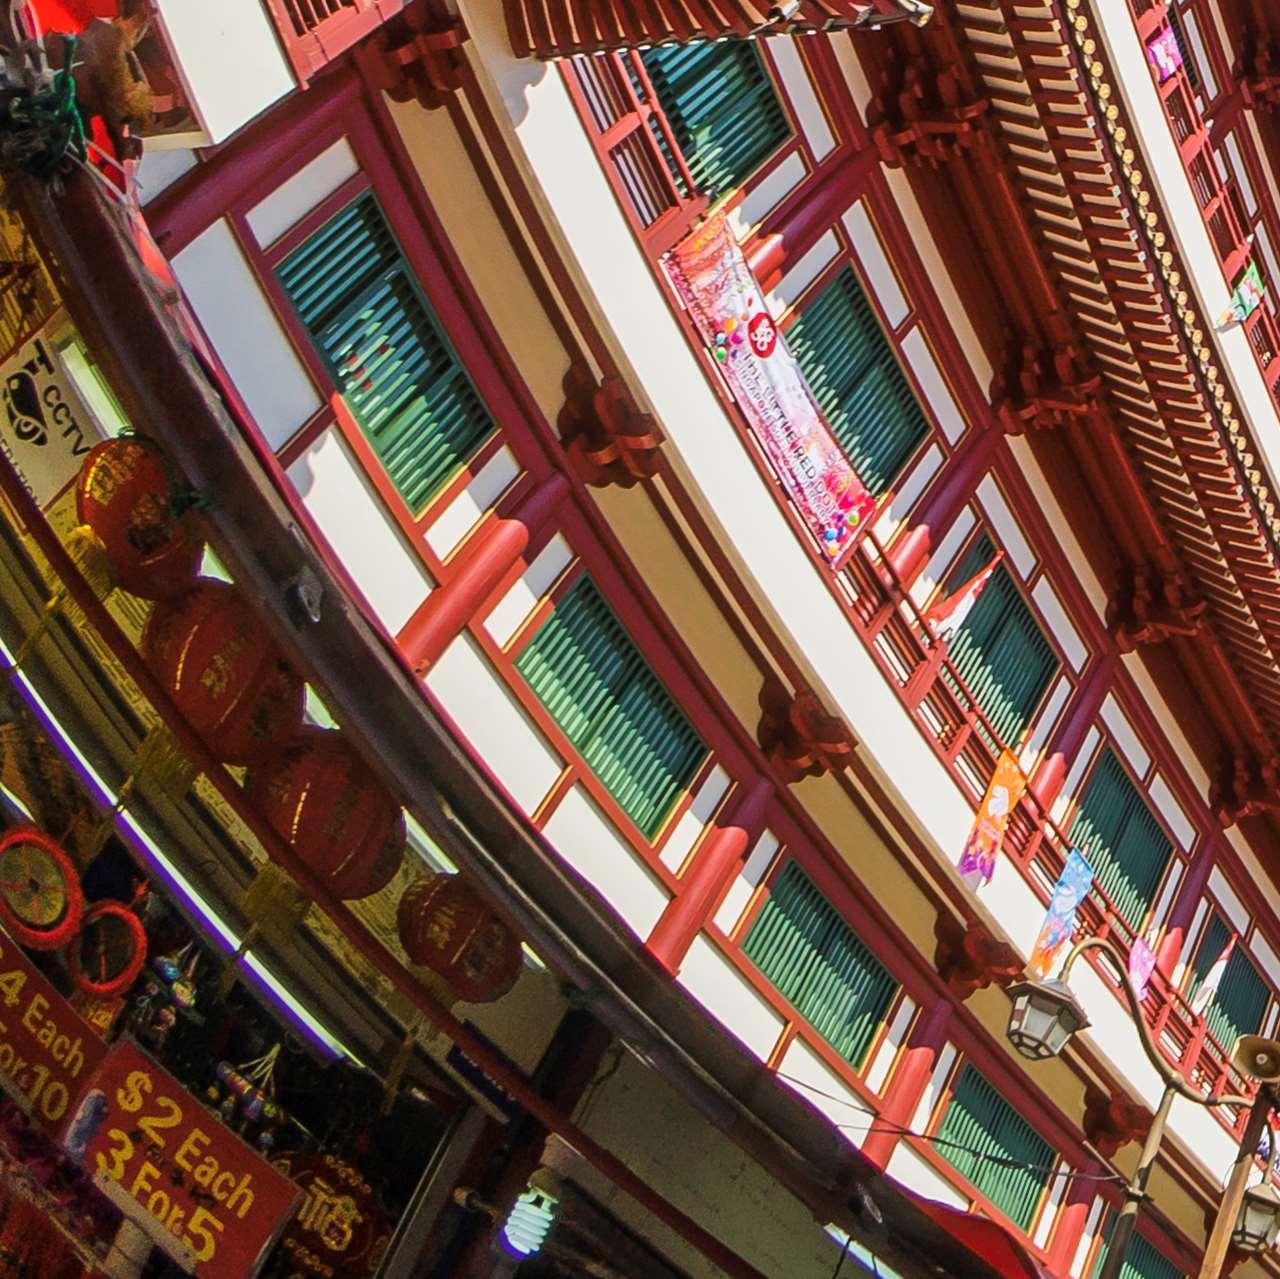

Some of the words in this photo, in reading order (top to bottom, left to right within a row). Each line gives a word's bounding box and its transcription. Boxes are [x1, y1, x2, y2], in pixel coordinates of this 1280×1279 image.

[43, 384, 91, 457] CCTV
[793, 446, 818, 480] RED
[22, 993, 85, 1078] Each
[117, 1071, 183, 1148] $2
[174, 1128, 255, 1218] Each
[96, 1129, 134, 1180] 3
[131, 1161, 187, 1235] For
[182, 1205, 224, 1262] 5
